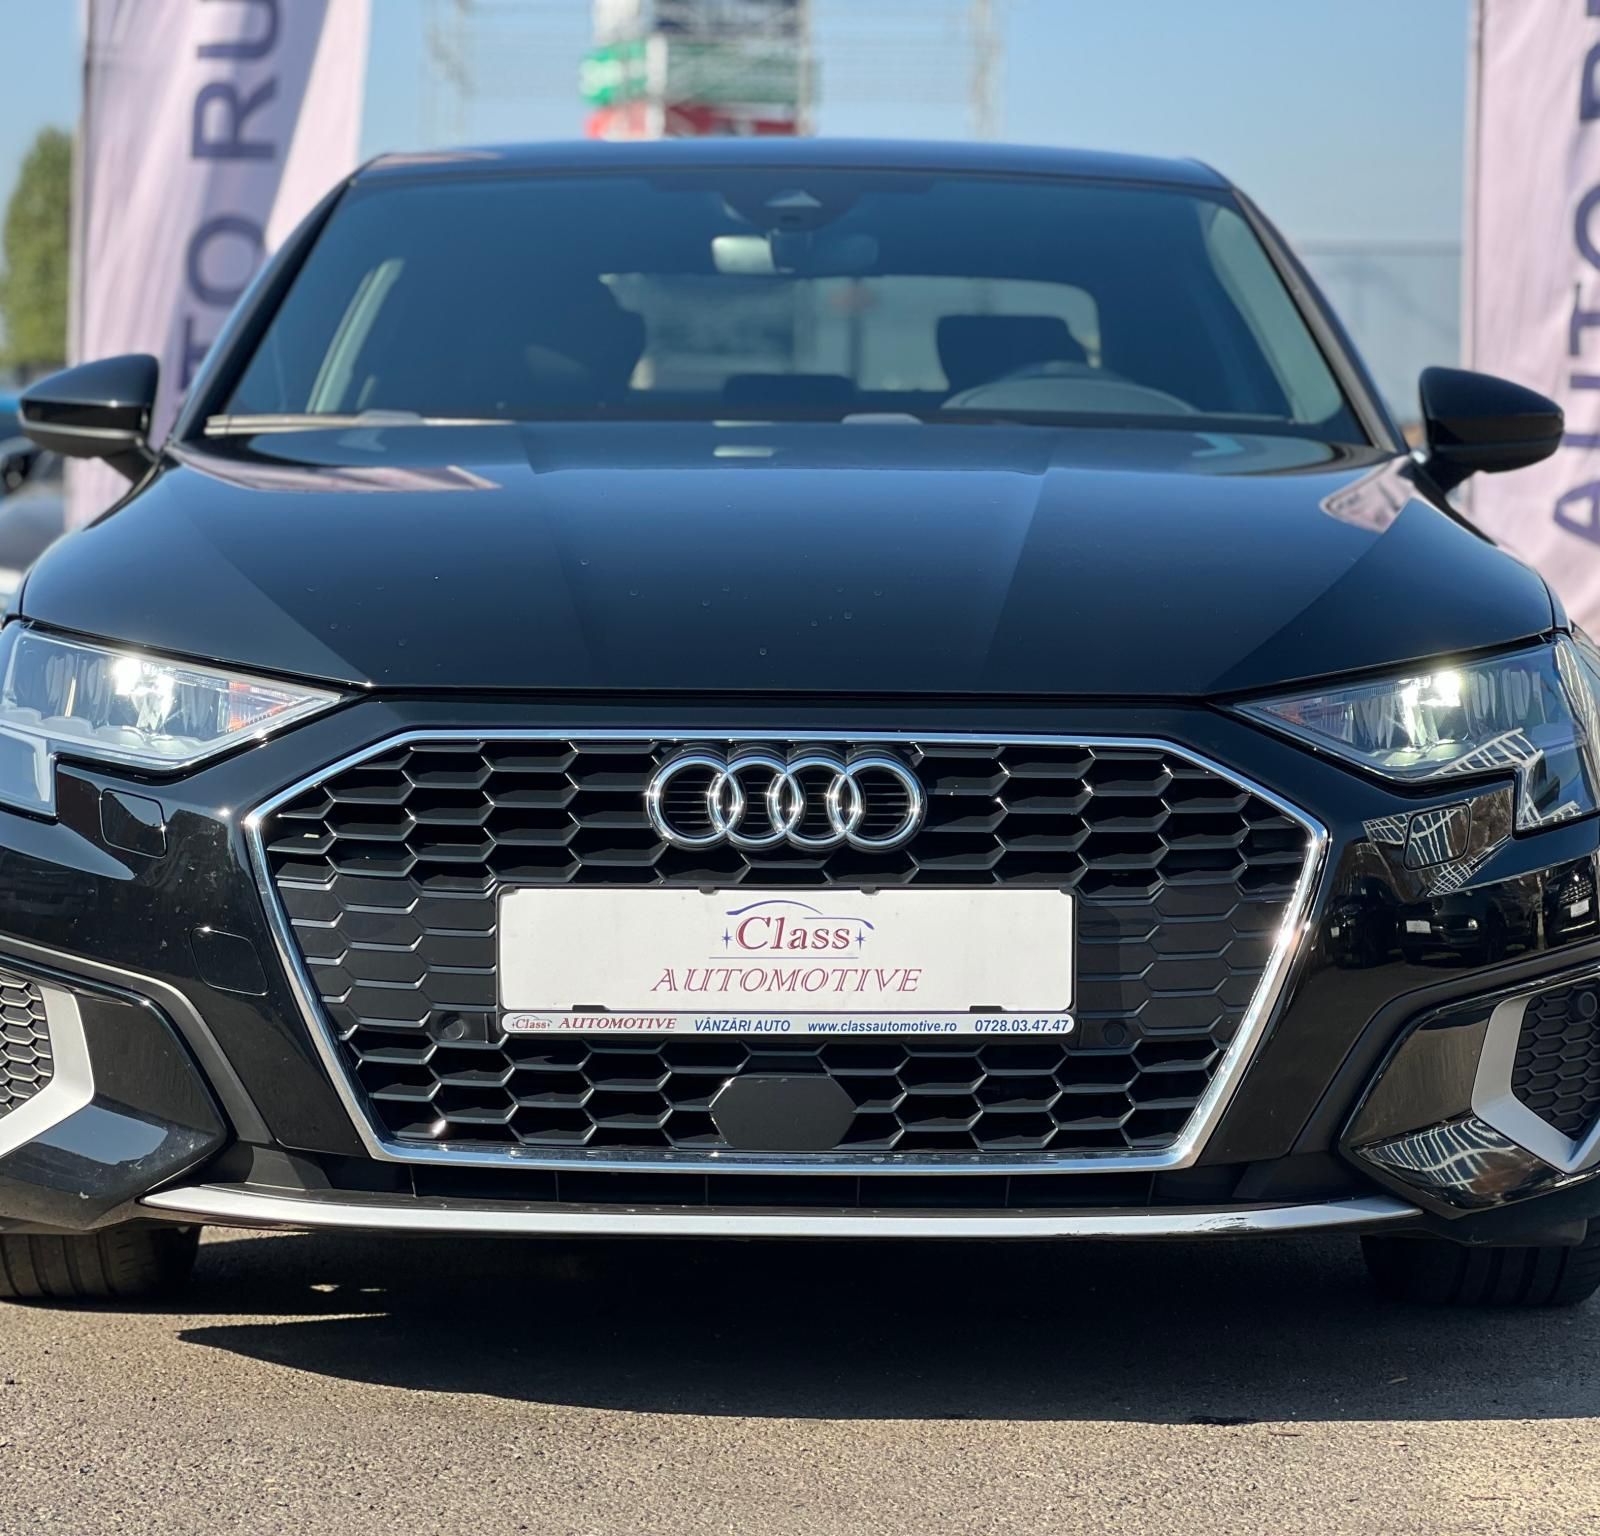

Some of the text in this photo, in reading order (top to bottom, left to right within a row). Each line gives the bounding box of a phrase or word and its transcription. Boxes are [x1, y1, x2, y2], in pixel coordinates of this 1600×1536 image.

[735, 916, 850, 950] Class
[650, 968, 922, 992] AUTOMOTIVE
[515, 1017, 1069, 1032] Class AUTOMOTIVE VÂNZĂRI AUTO www.classautomotive.ro 0728.03.47.47
